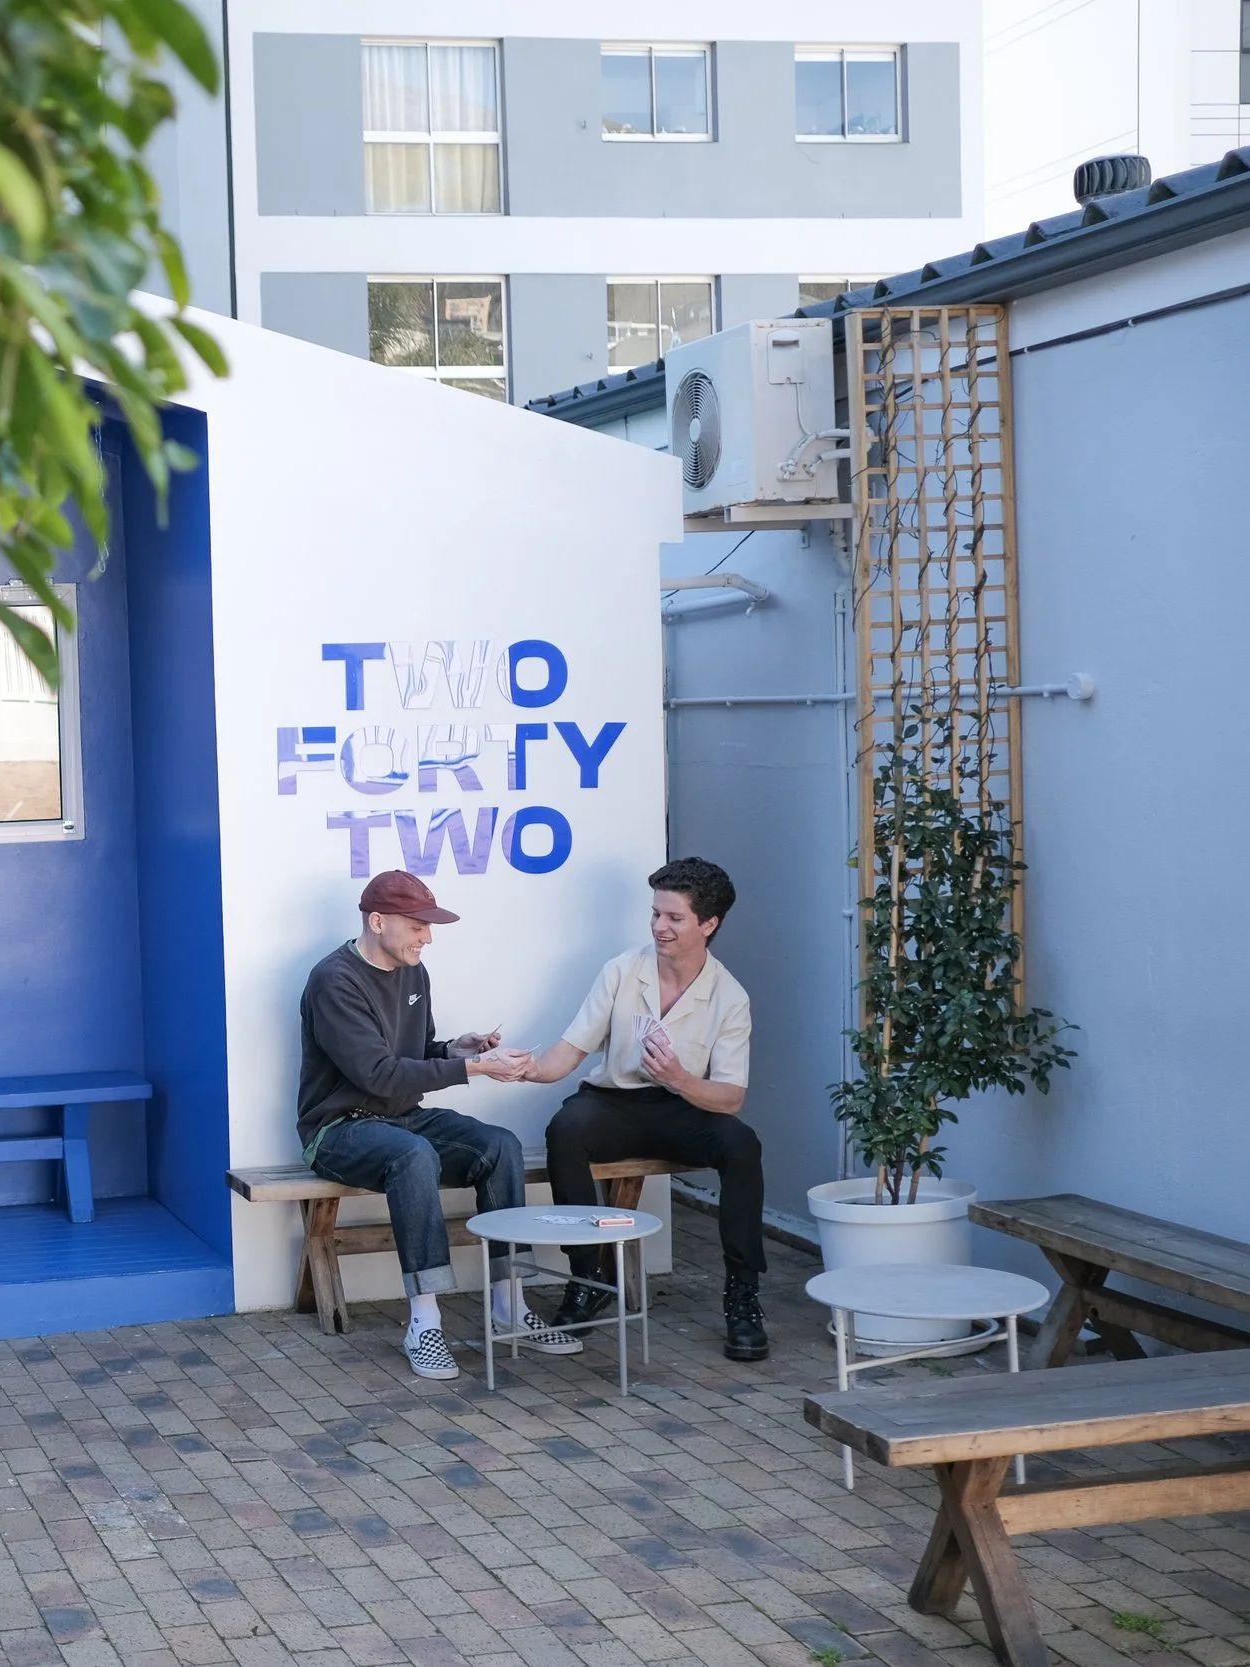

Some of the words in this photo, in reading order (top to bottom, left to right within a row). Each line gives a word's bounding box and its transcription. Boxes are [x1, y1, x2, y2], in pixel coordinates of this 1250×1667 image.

[321, 639, 568, 711] TWO
[276, 721, 628, 795] FORTY
[326, 805, 573, 878] TWO
